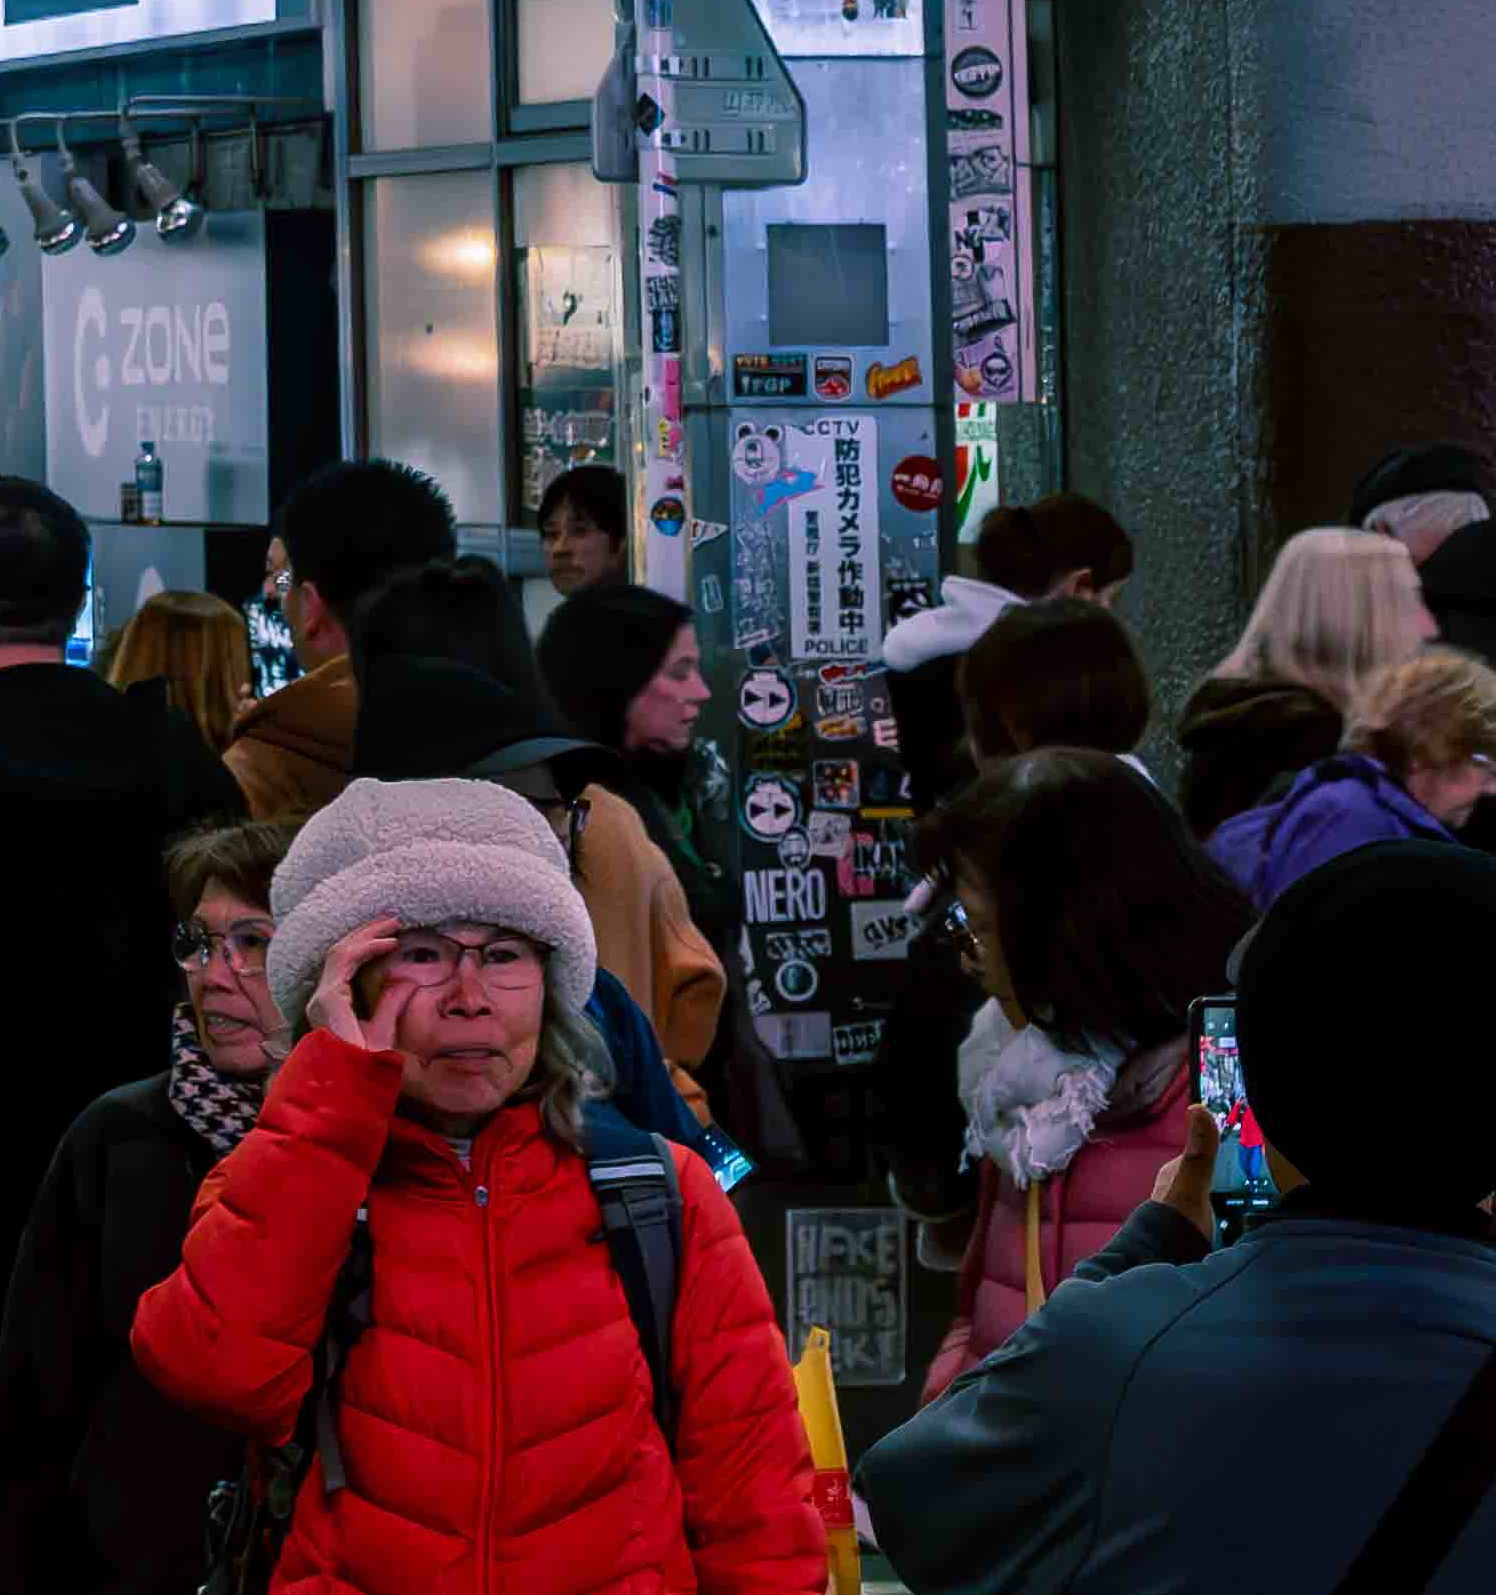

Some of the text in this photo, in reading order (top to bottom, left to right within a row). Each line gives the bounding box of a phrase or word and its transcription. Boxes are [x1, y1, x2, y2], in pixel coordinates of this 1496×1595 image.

[834, 438, 865, 635] 防犯カメラ作動中
[804, 638, 869, 655] POLICE
[743, 867, 827, 923] NERO
